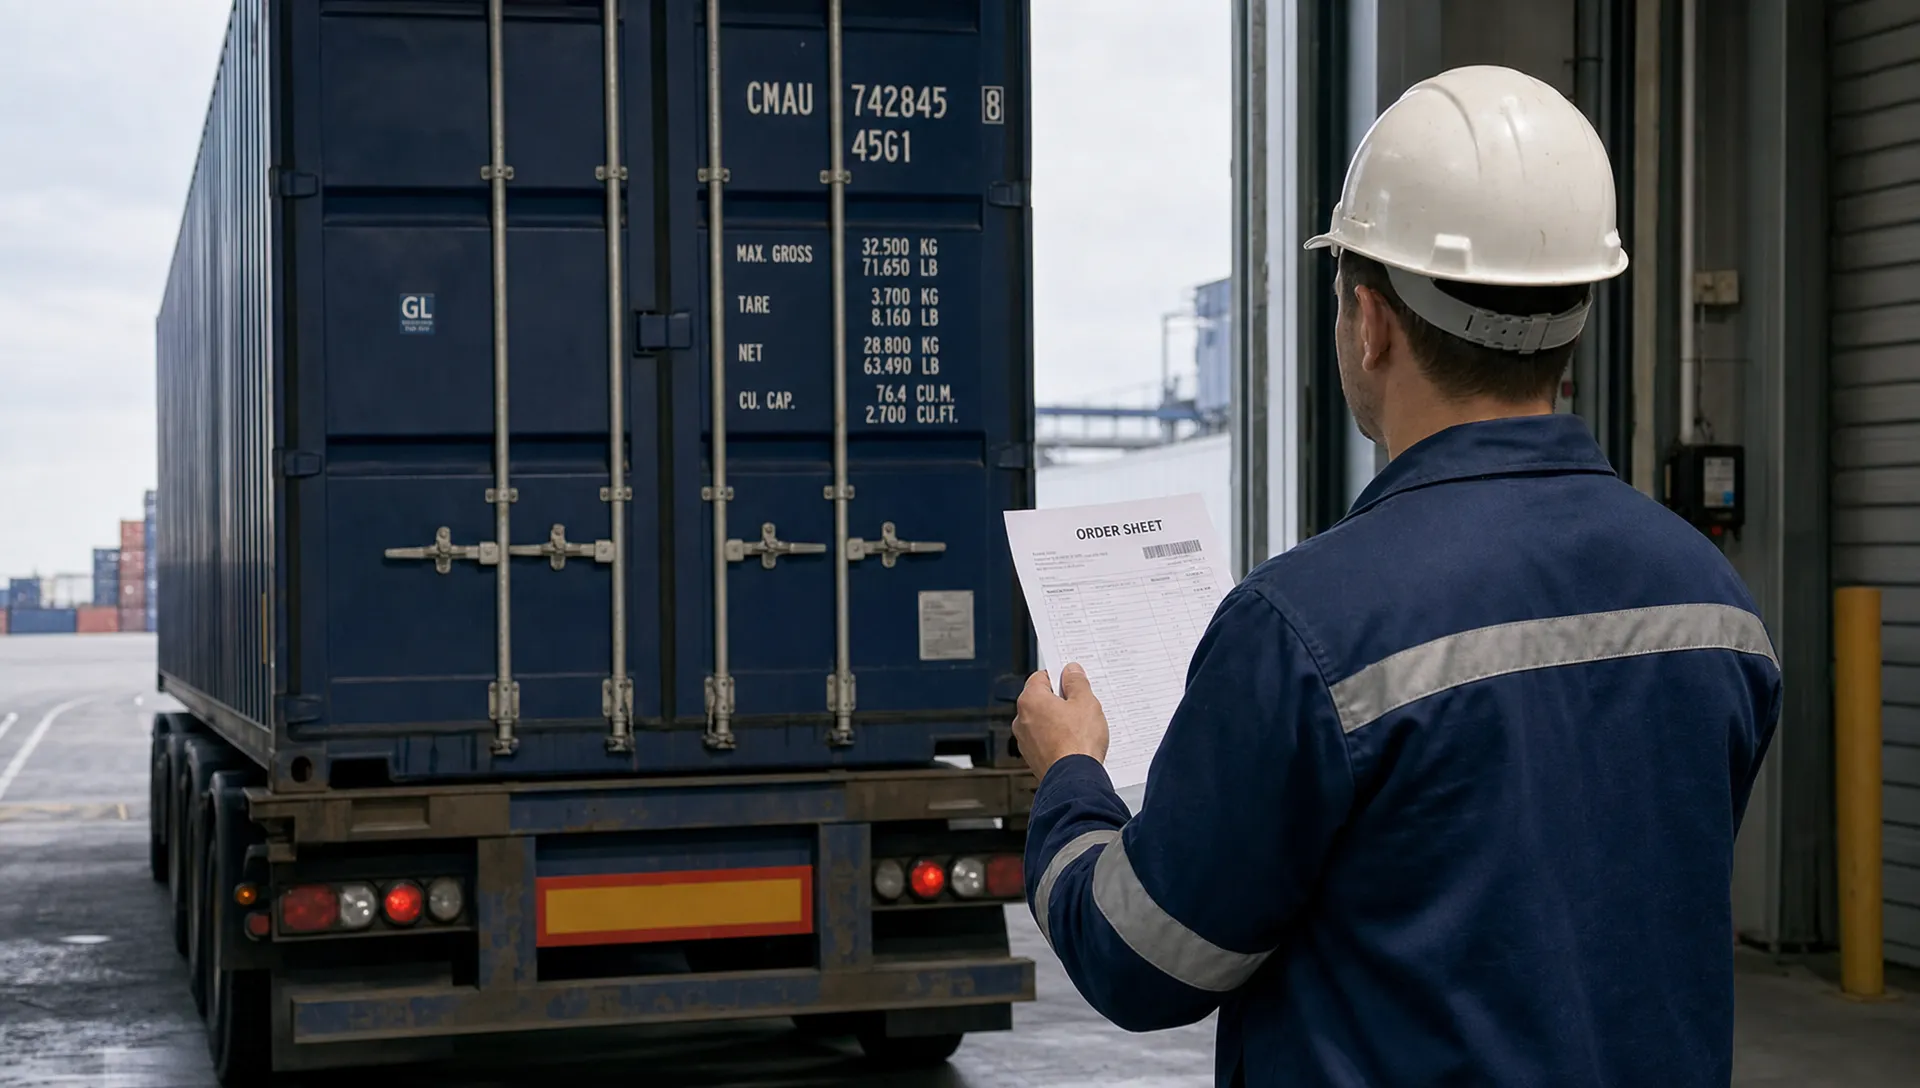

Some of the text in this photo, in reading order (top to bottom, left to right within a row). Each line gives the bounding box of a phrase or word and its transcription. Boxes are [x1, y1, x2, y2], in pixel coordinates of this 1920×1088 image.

[746, 81, 1000, 120] CMAU 742845 8
[851, 129, 911, 163] 45G1
[736, 244, 813, 263] MAX. GROSS
[862, 237, 938, 256] 32.500 KG
[862, 257, 938, 277] 71.650 LB
[738, 295, 771, 314] TARE
[871, 287, 939, 306] 3.700 KG
[401, 295, 433, 319] GL
[871, 308, 939, 327] 8.160 LB
[738, 343, 763, 362] NET
[863, 336, 940, 355] 28.800 KG
[863, 356, 940, 375] 63.490 LB
[739, 391, 796, 410] CU. CAP.
[876, 384, 955, 403] 76.4 CU.M.
[865, 404, 959, 423] 2.700 CU.FT.
[1076, 519, 1163, 540] ORDER SHEET
